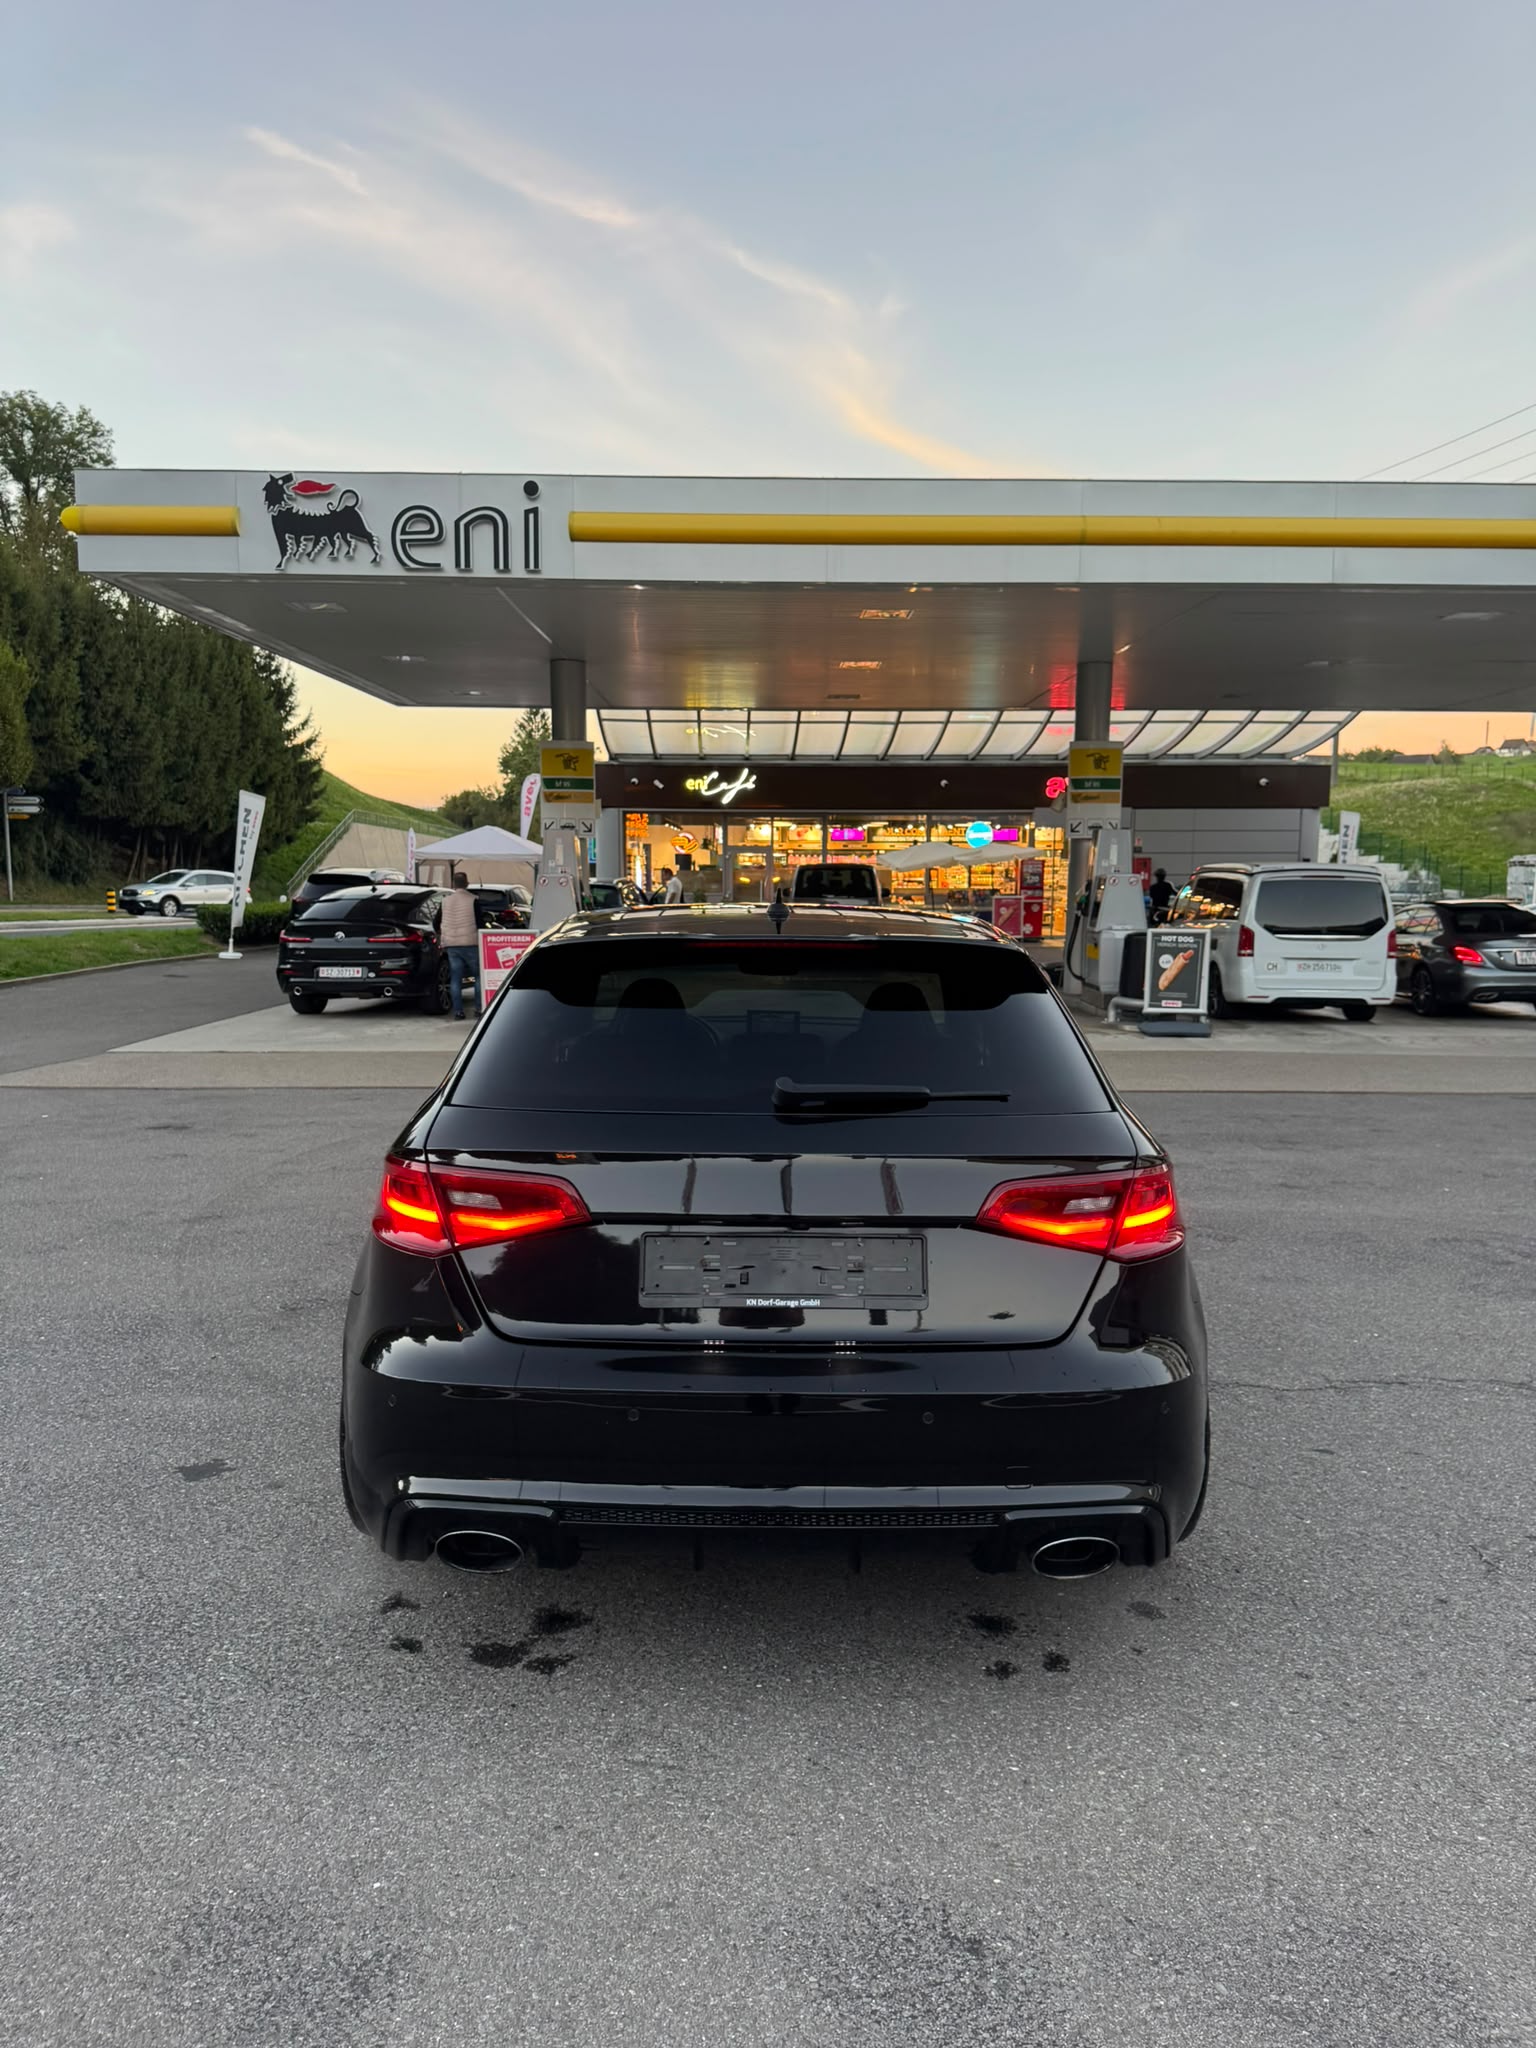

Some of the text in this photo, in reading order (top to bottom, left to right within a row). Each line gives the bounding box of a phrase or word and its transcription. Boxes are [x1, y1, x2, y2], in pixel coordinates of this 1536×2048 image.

[391, 480, 542, 571] eni
[686, 775, 708, 791] eni
[1266, 962, 1278, 971] CH
[757, 1298, 799, 1308] Dorf-Garage
[799, 1298, 820, 1306] GmbH
